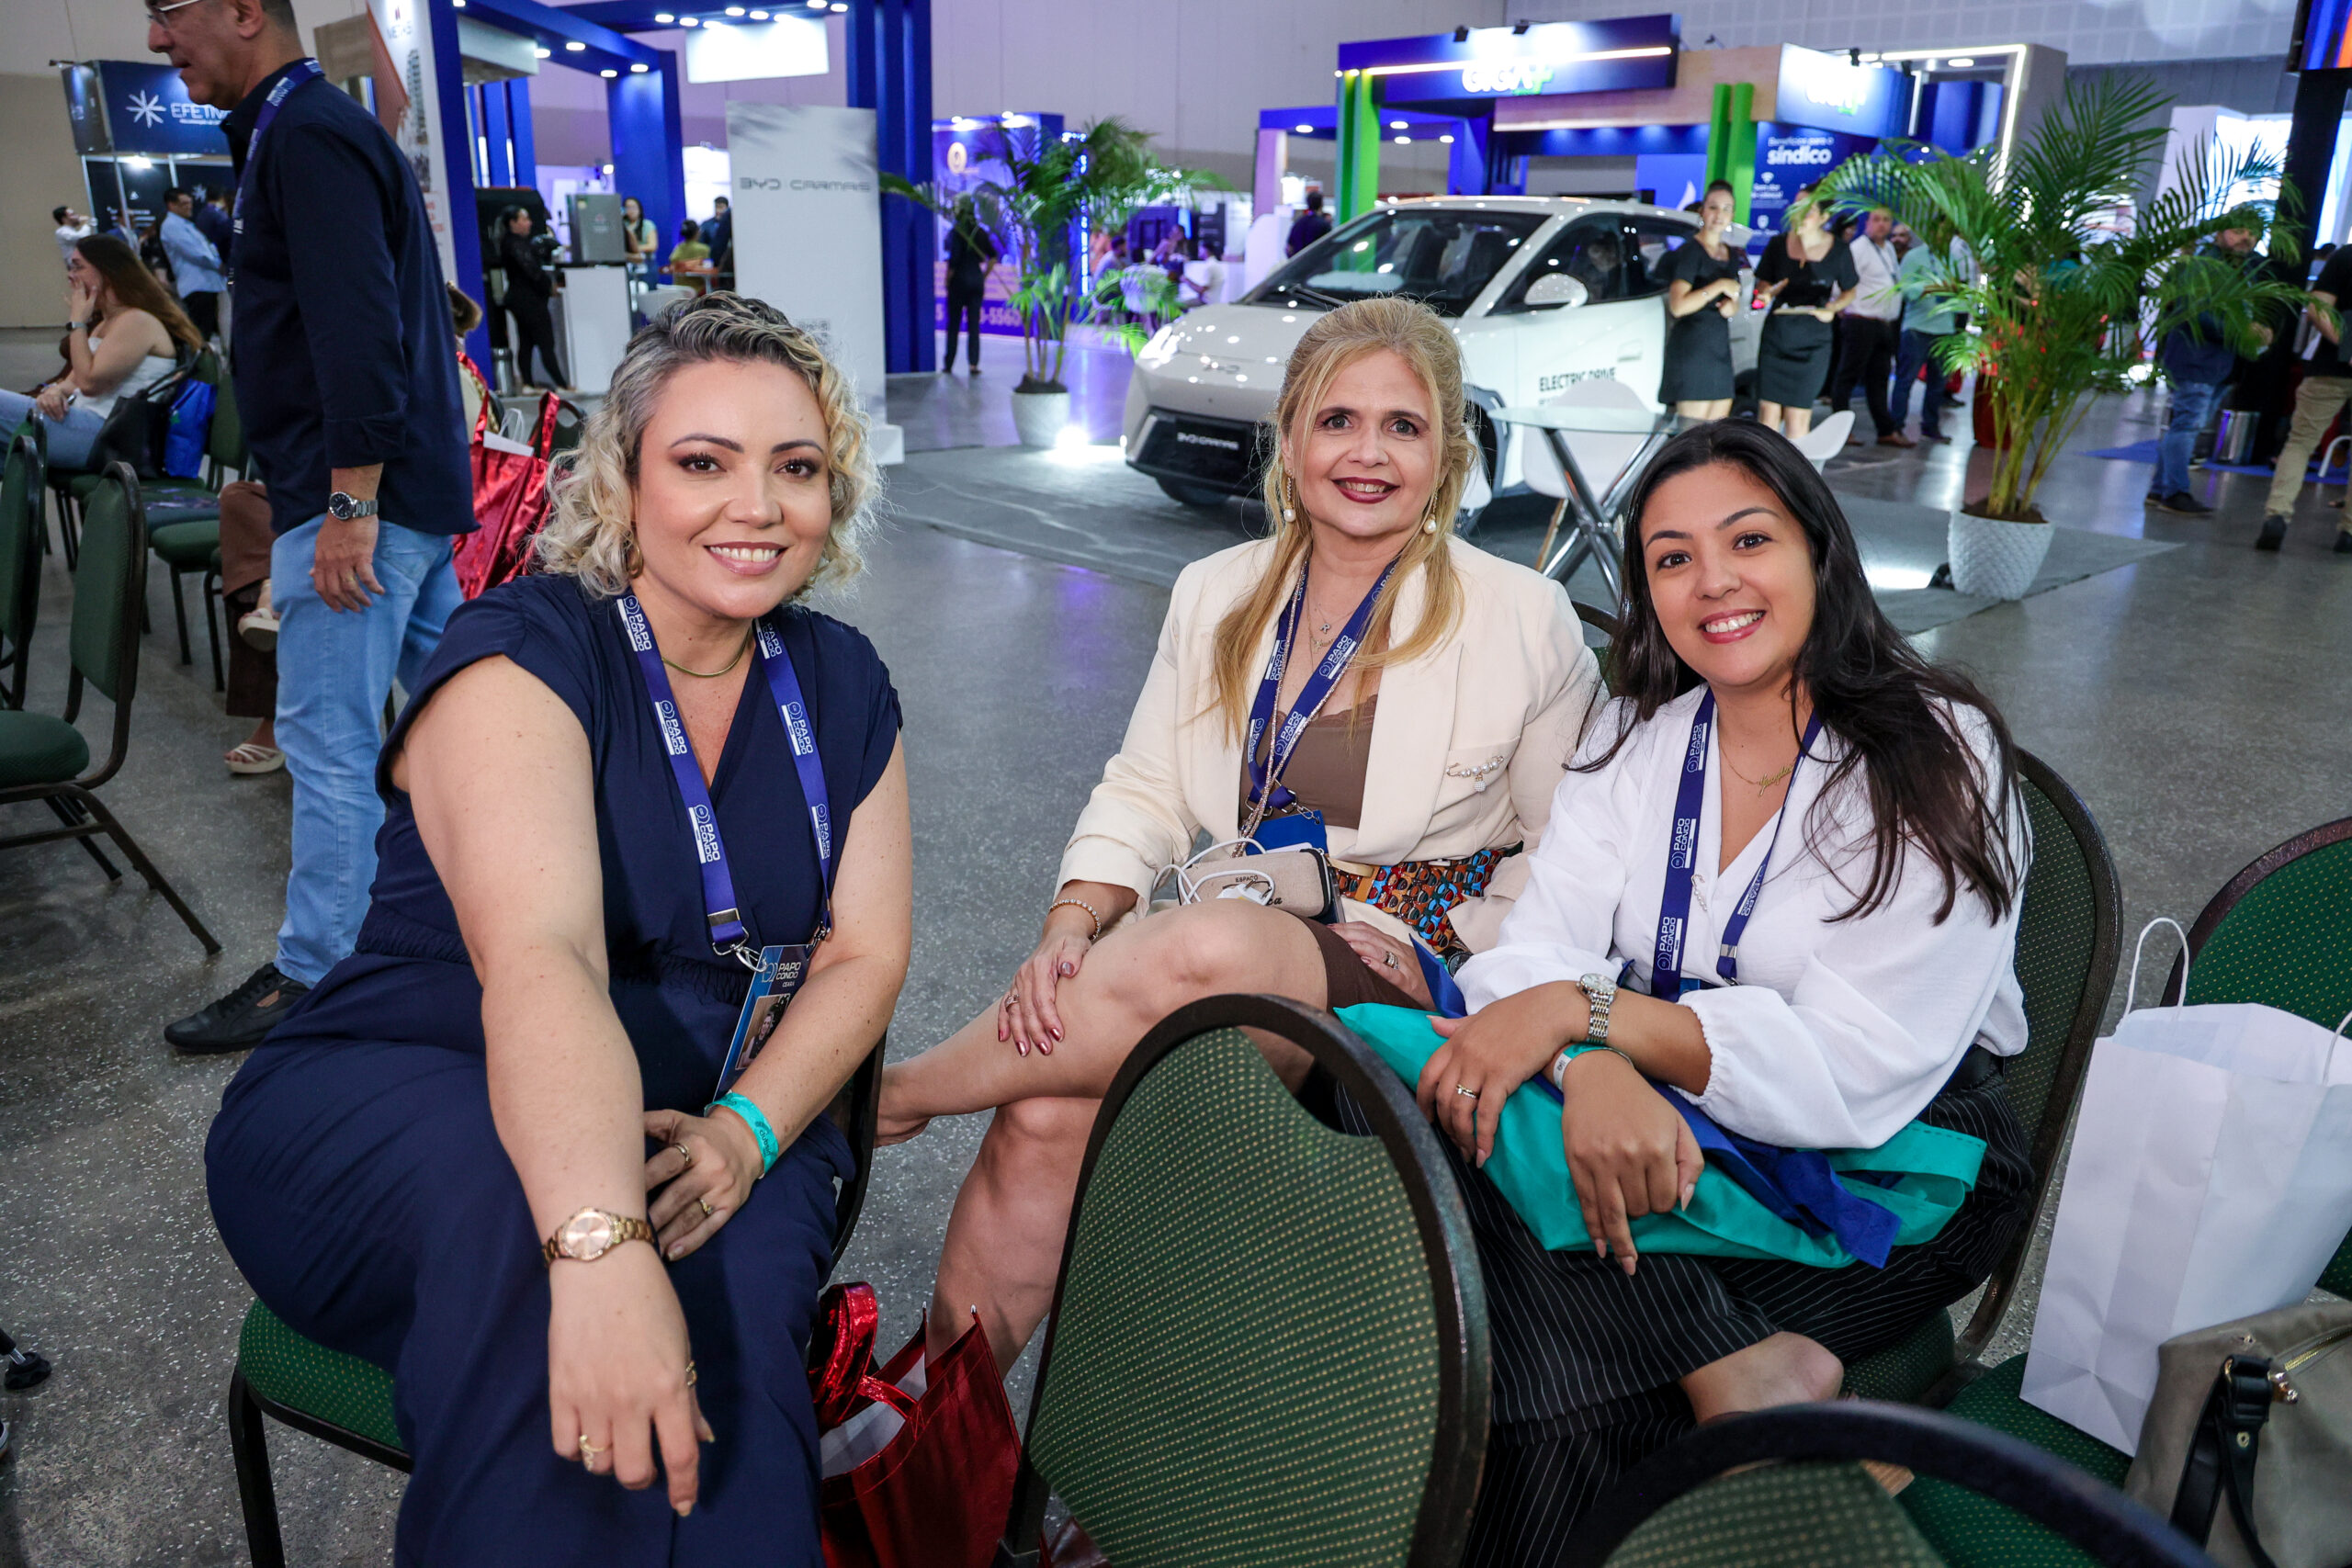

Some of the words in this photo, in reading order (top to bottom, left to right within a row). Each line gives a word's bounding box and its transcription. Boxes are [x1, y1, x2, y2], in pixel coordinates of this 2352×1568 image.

[1767, 145, 1832, 164] síndico
[628, 615, 645, 651] CONDO
[634, 614, 652, 650] PAPO
[1328, 635, 1349, 661] PAPO
[1332, 638, 1353, 663] CONDO
[666, 720, 681, 755] CONDO
[671, 718, 687, 754] PAPO
[793, 721, 808, 754] CONDO
[798, 719, 814, 753] PAPO
[1280, 711, 1299, 739] PAPO
[1690, 725, 1699, 756] PAPO
[1694, 723, 1703, 755] CONDO
[699, 825, 713, 863] CONDO
[706, 823, 721, 861] PAPO
[1673, 818, 1685, 851] PAPO
[1680, 818, 1690, 852] CONDO
[1659, 916, 1670, 952] PAPO
[1666, 917, 1677, 953] CONDO
[775, 971, 798, 980] CONDO
[778, 962, 801, 972] PAPO
